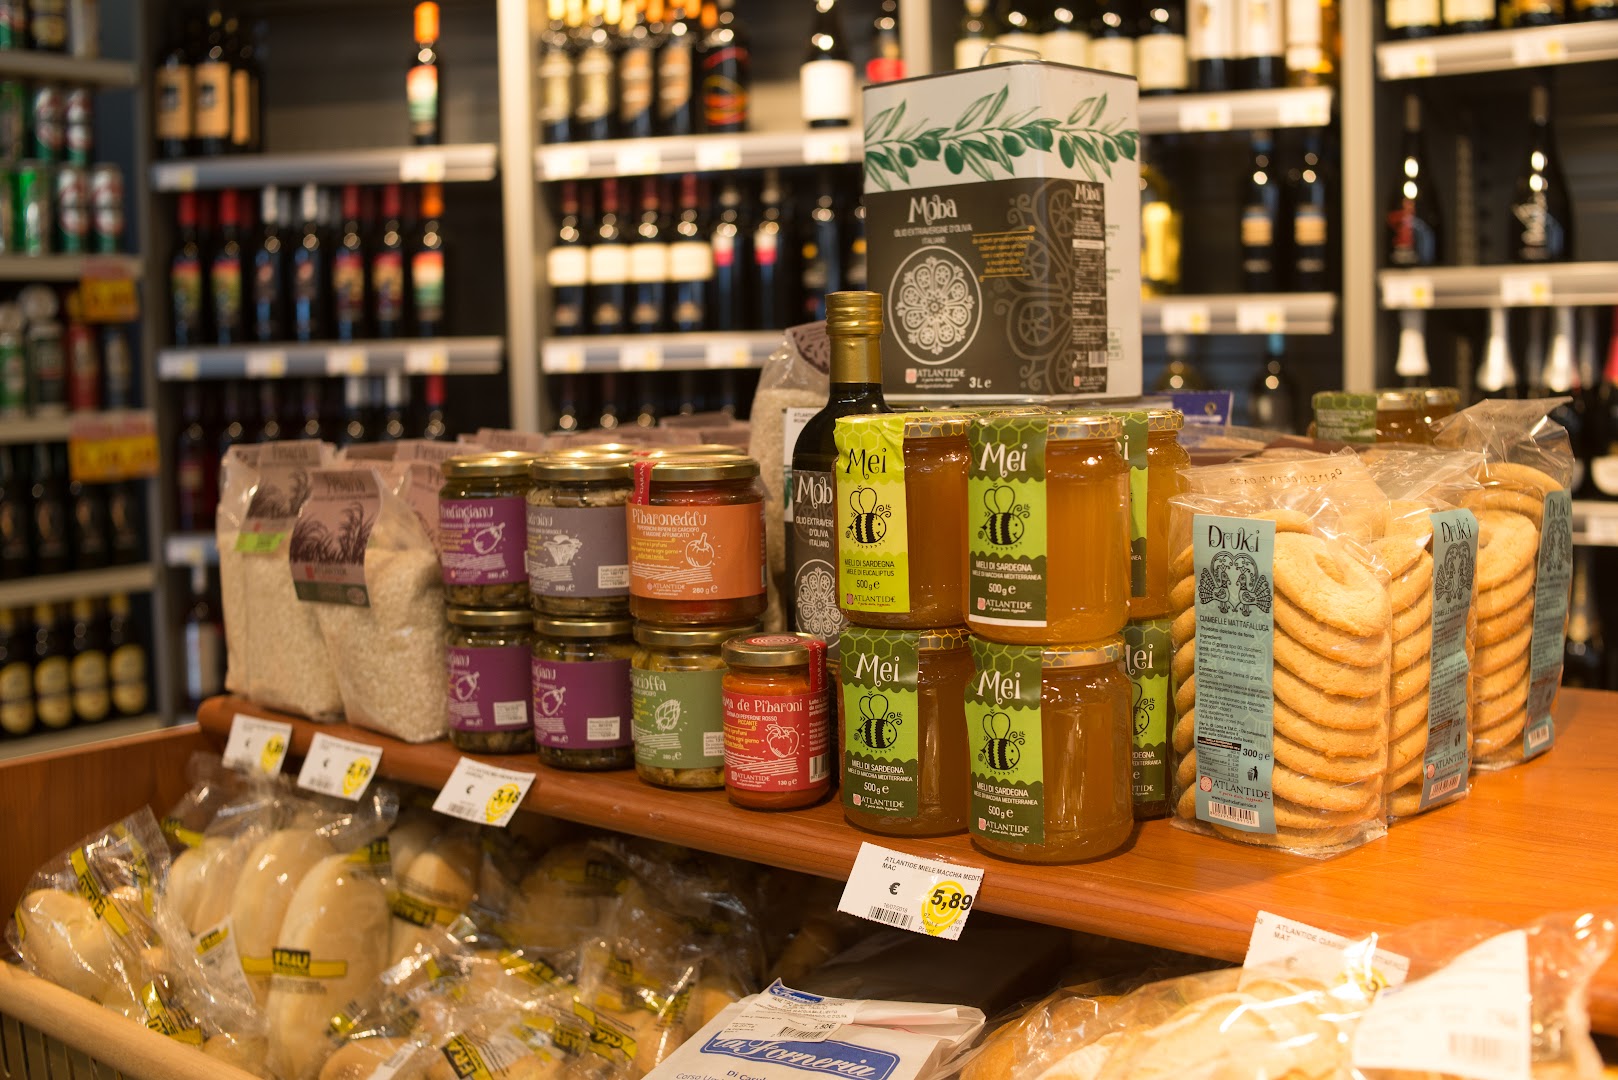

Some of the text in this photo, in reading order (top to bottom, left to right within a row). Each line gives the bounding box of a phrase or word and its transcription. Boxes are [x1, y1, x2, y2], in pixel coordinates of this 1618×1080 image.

[907, 194, 958, 225] Moba
[908, 226, 949, 237] EXTRAVERGINE
[917, 368, 966, 378] ATLANTIDE
[845, 448, 887, 480] Mei
[979, 442, 1028, 478] Mei
[795, 475, 833, 509] Mob
[632, 508, 707, 527] Pibaroneddu
[795, 516, 807, 525] OLIO
[809, 528, 829, 538] D'OLIVA
[1441, 517, 1472, 543] Druki
[809, 538, 830, 548] ITALIANO
[1208, 525, 1260, 552] Druki
[862, 560, 895, 568] SARDEGNA
[996, 562, 1033, 572] SARDEGNA
[1003, 573, 1042, 581] MEDITERRANEA
[853, 594, 896, 603] ATLANTIDE
[985, 598, 1033, 610] ATLANTIDE
[1199, 614, 1270, 632] CIAMBELLE MATTAFALLUGA
[854, 652, 900, 688] Mei
[976, 670, 1022, 705] Mei
[737, 698, 803, 713] de Pibaroni
[737, 719, 758, 727] PICCANTE
[1242, 748, 1258, 758] 300
[1258, 753, 1263, 761] g
[1435, 752, 1467, 770] ATLANTIDE
[870, 763, 905, 775] SARDEGNA
[736, 773, 771, 782] ATLANTIDE
[877, 774, 913, 782] MEDITERRANEA
[994, 786, 1029, 797] SARDEGNA
[1212, 779, 1271, 800] ATLANTIDE
[861, 796, 905, 808] ATLANTIDE
[1001, 797, 1039, 806] MEDITERRANEA
[985, 820, 1030, 834] ATLANTIDE
[881, 862, 897, 872] MAC
[884, 856, 918, 871] ATLANTIDE
[918, 864, 937, 874] MIELE
[936, 868, 963, 879] MACCHIA
[888, 882, 901, 896] €
[930, 888, 973, 911] 5,89
[1273, 932, 1291, 942] MAT
[1275, 924, 1317, 942] ATLANTIDE
[726, 1070, 738, 1078] Di
